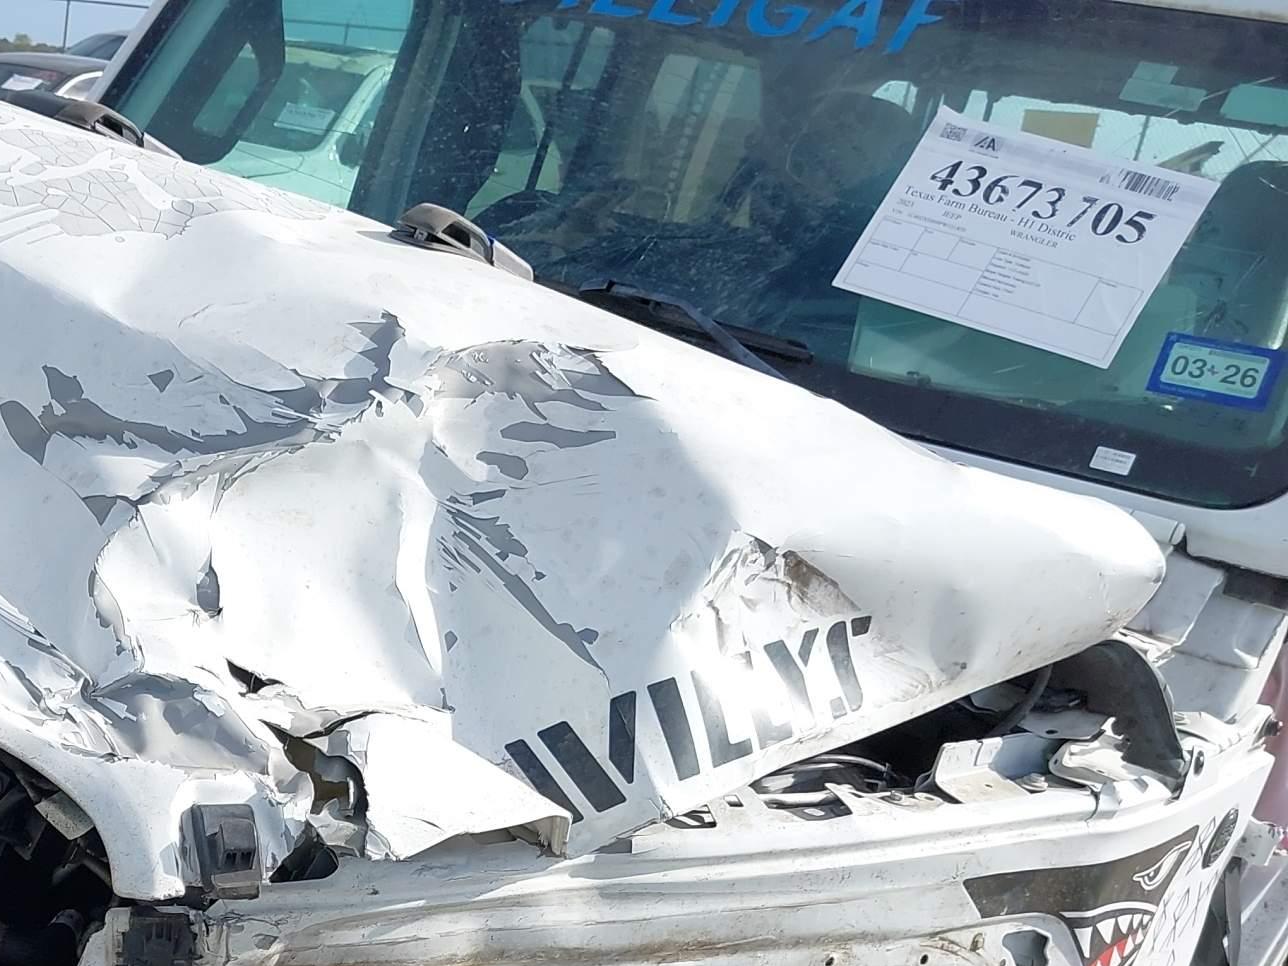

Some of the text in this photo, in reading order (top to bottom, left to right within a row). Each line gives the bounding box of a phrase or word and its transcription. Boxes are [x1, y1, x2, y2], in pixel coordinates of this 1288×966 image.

[905, 185, 935, 201] Texas
[937, 193, 966, 212] Farm
[968, 204, 1008, 223] Bureau
[1034, 219, 1076, 241] Distric
[1010, 229, 1058, 249] WRANGLER
